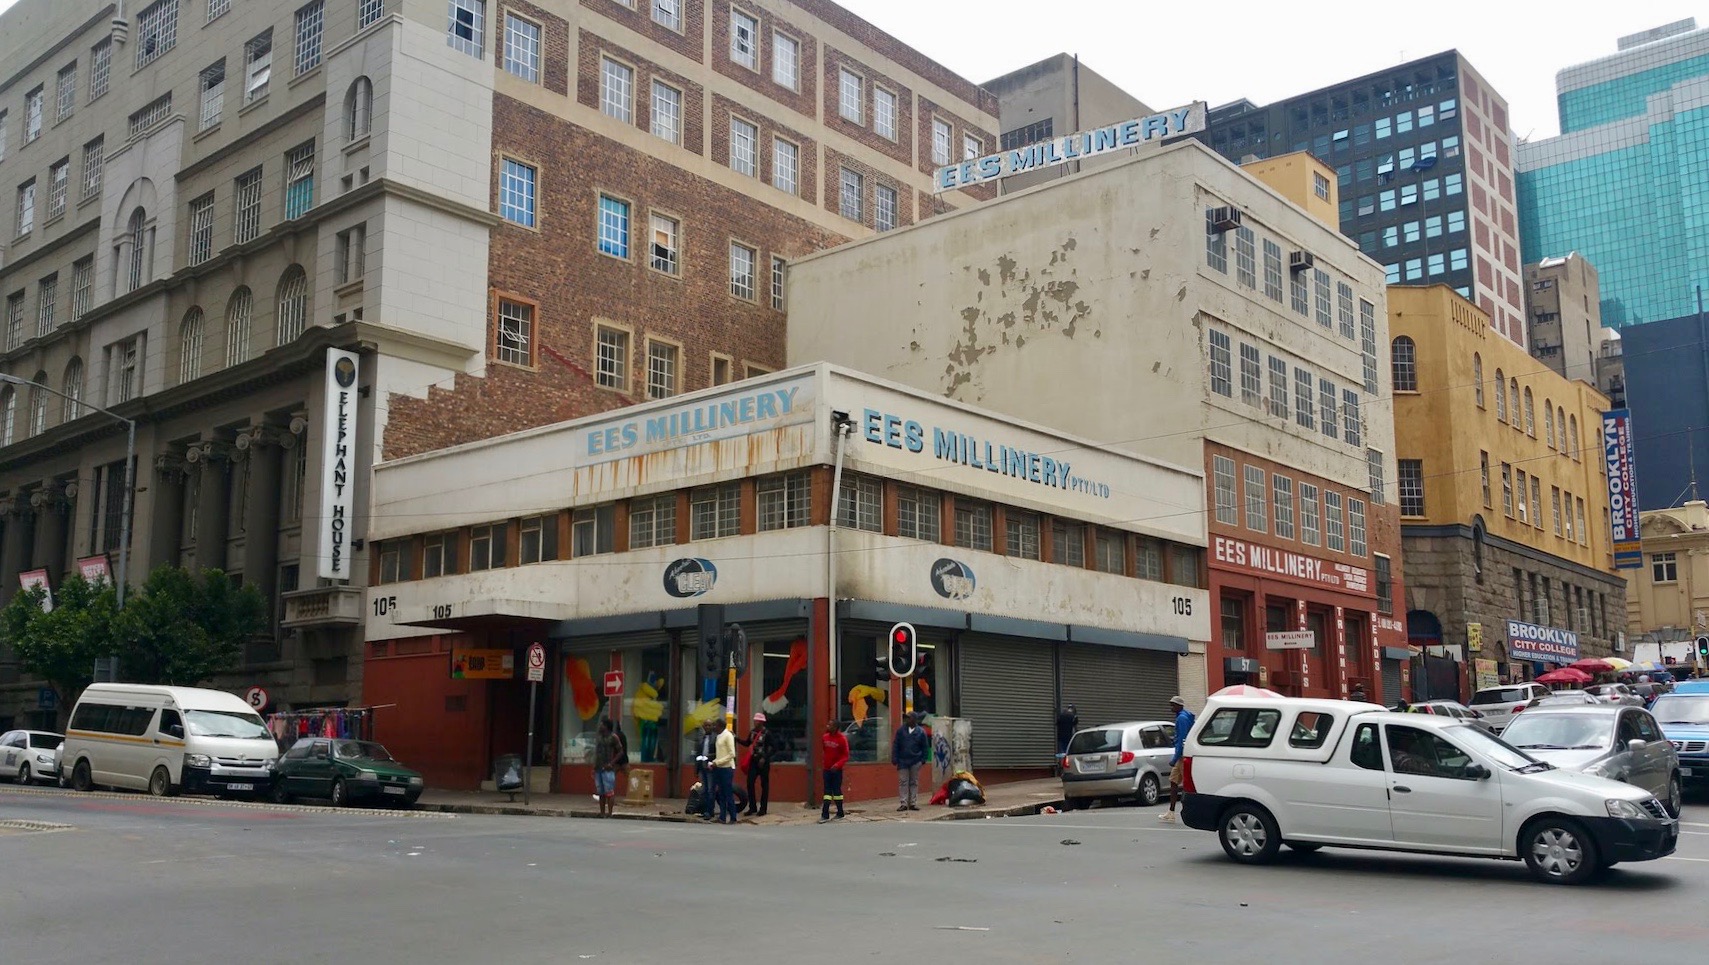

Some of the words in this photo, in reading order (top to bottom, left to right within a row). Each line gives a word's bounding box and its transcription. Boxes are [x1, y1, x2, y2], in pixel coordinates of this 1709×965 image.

[941, 155, 1001, 188] EES
[1009, 108, 1190, 172] MILLINERY
[334, 391, 349, 498] ELEPHANT
[587, 421, 638, 457] EES
[645, 386, 800, 445] MILLINERY
[863, 408, 924, 454] EES
[933, 426, 1071, 490] MILLINERY
[1604, 418, 1626, 540] BROOKLYN
[1617, 426, 1630, 491] COLLEGE
[331, 504, 345, 572] HOUSE
[1623, 495, 1633, 529] CITY
[1215, 537, 1246, 566] EES
[1250, 545, 1322, 581] MILLINERY
[373, 596, 397, 616] 105
[433, 604, 452, 619] 105
[1172, 596, 1192, 616] 105
[1508, 622, 1577, 647] BROOKLYN
[1241, 659, 1250, 671] 57
[1298, 600, 1310, 688] FAICS
[1336, 606, 1349, 700] TRIMMIN
[1371, 612, 1380, 671] BEADS
[1512, 650, 1531, 658] HIGHER
[1531, 652, 1556, 661] EDUCATION
[1514, 639, 1537, 651] CITY
[1539, 642, 1577, 656] COLLEGE
